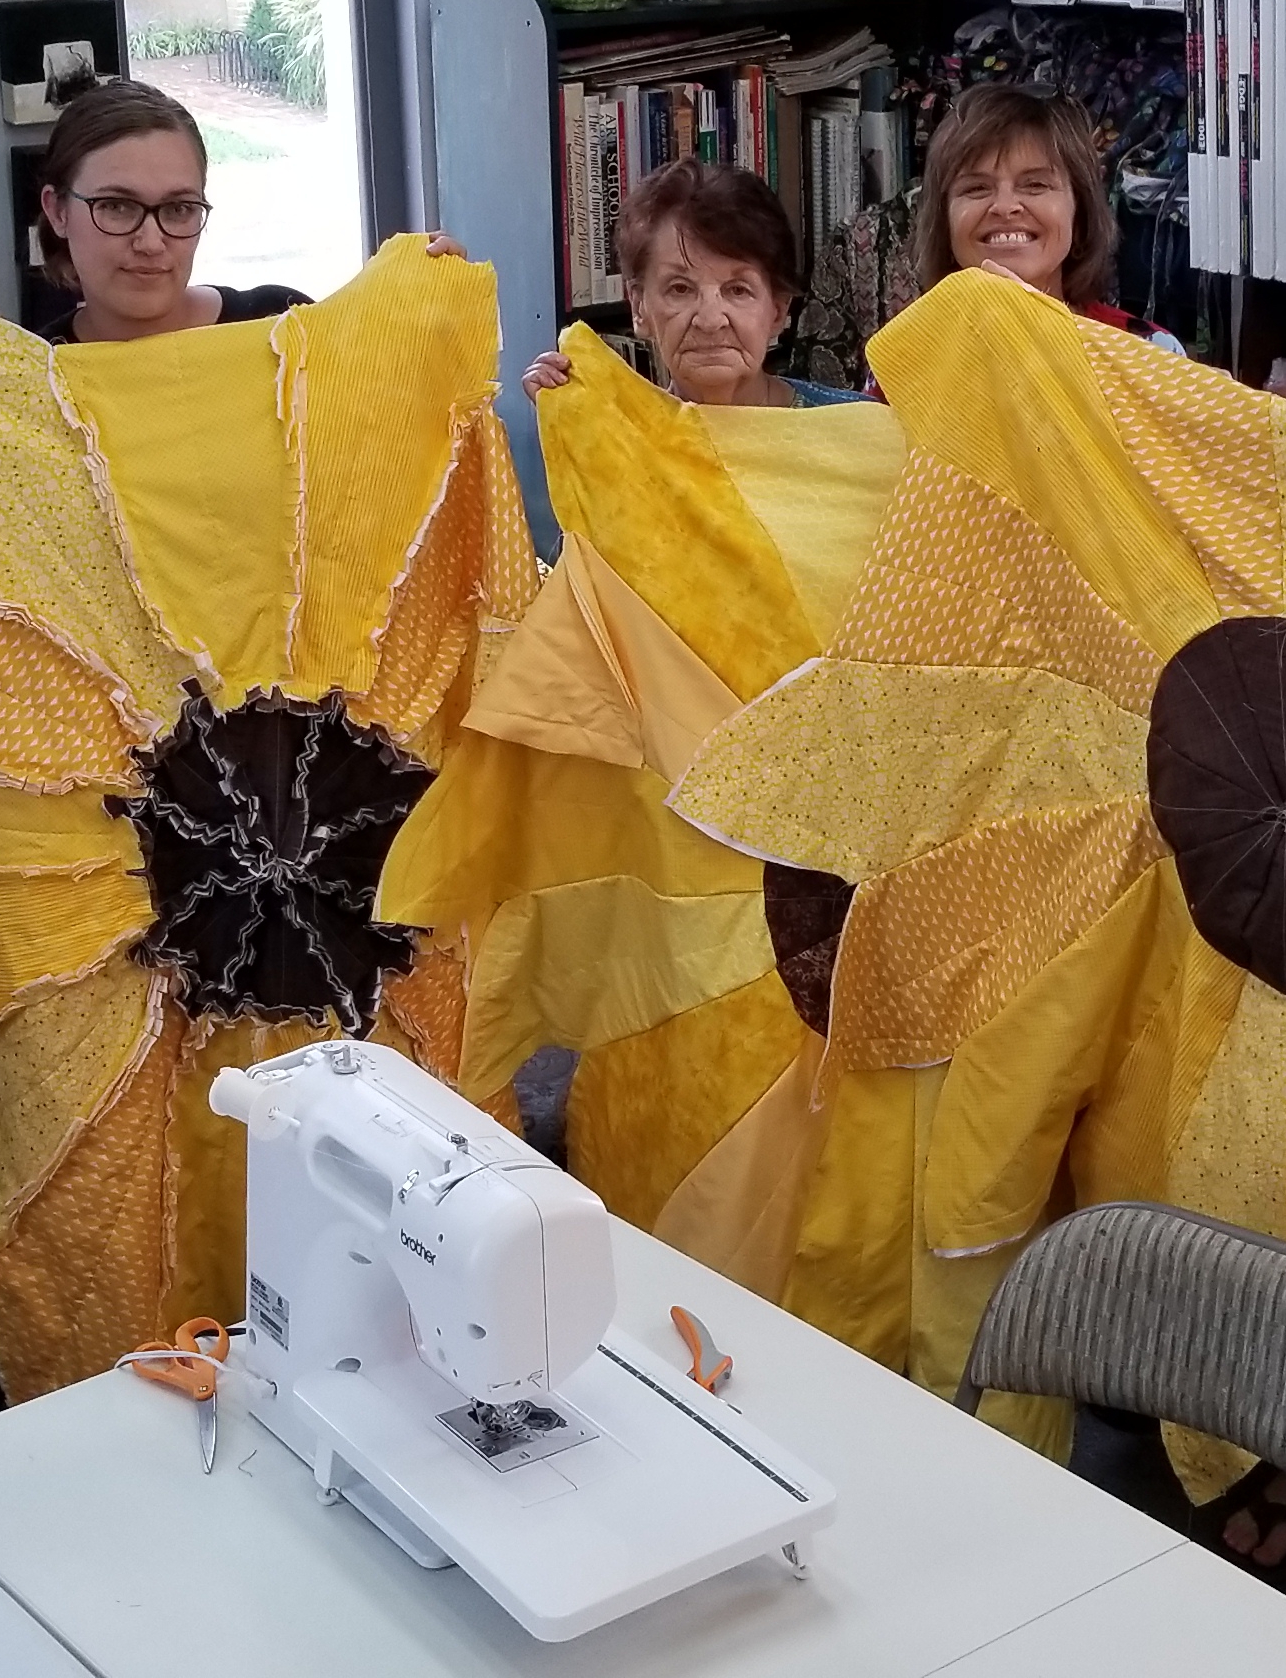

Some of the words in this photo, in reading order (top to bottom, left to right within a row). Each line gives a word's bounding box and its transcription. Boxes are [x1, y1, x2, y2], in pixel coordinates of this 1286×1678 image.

[1238, 80, 1246, 112] EDGE
[573, 114, 585, 148] Wild
[589, 113, 600, 133] The
[605, 113, 618, 146] ART
[590, 134, 602, 184] Chronicle
[606, 152, 620, 226] SCHOOL
[578, 230, 590, 269] World
[590, 197, 605, 271] Impressionism
[400, 1228, 437, 1266] brother
